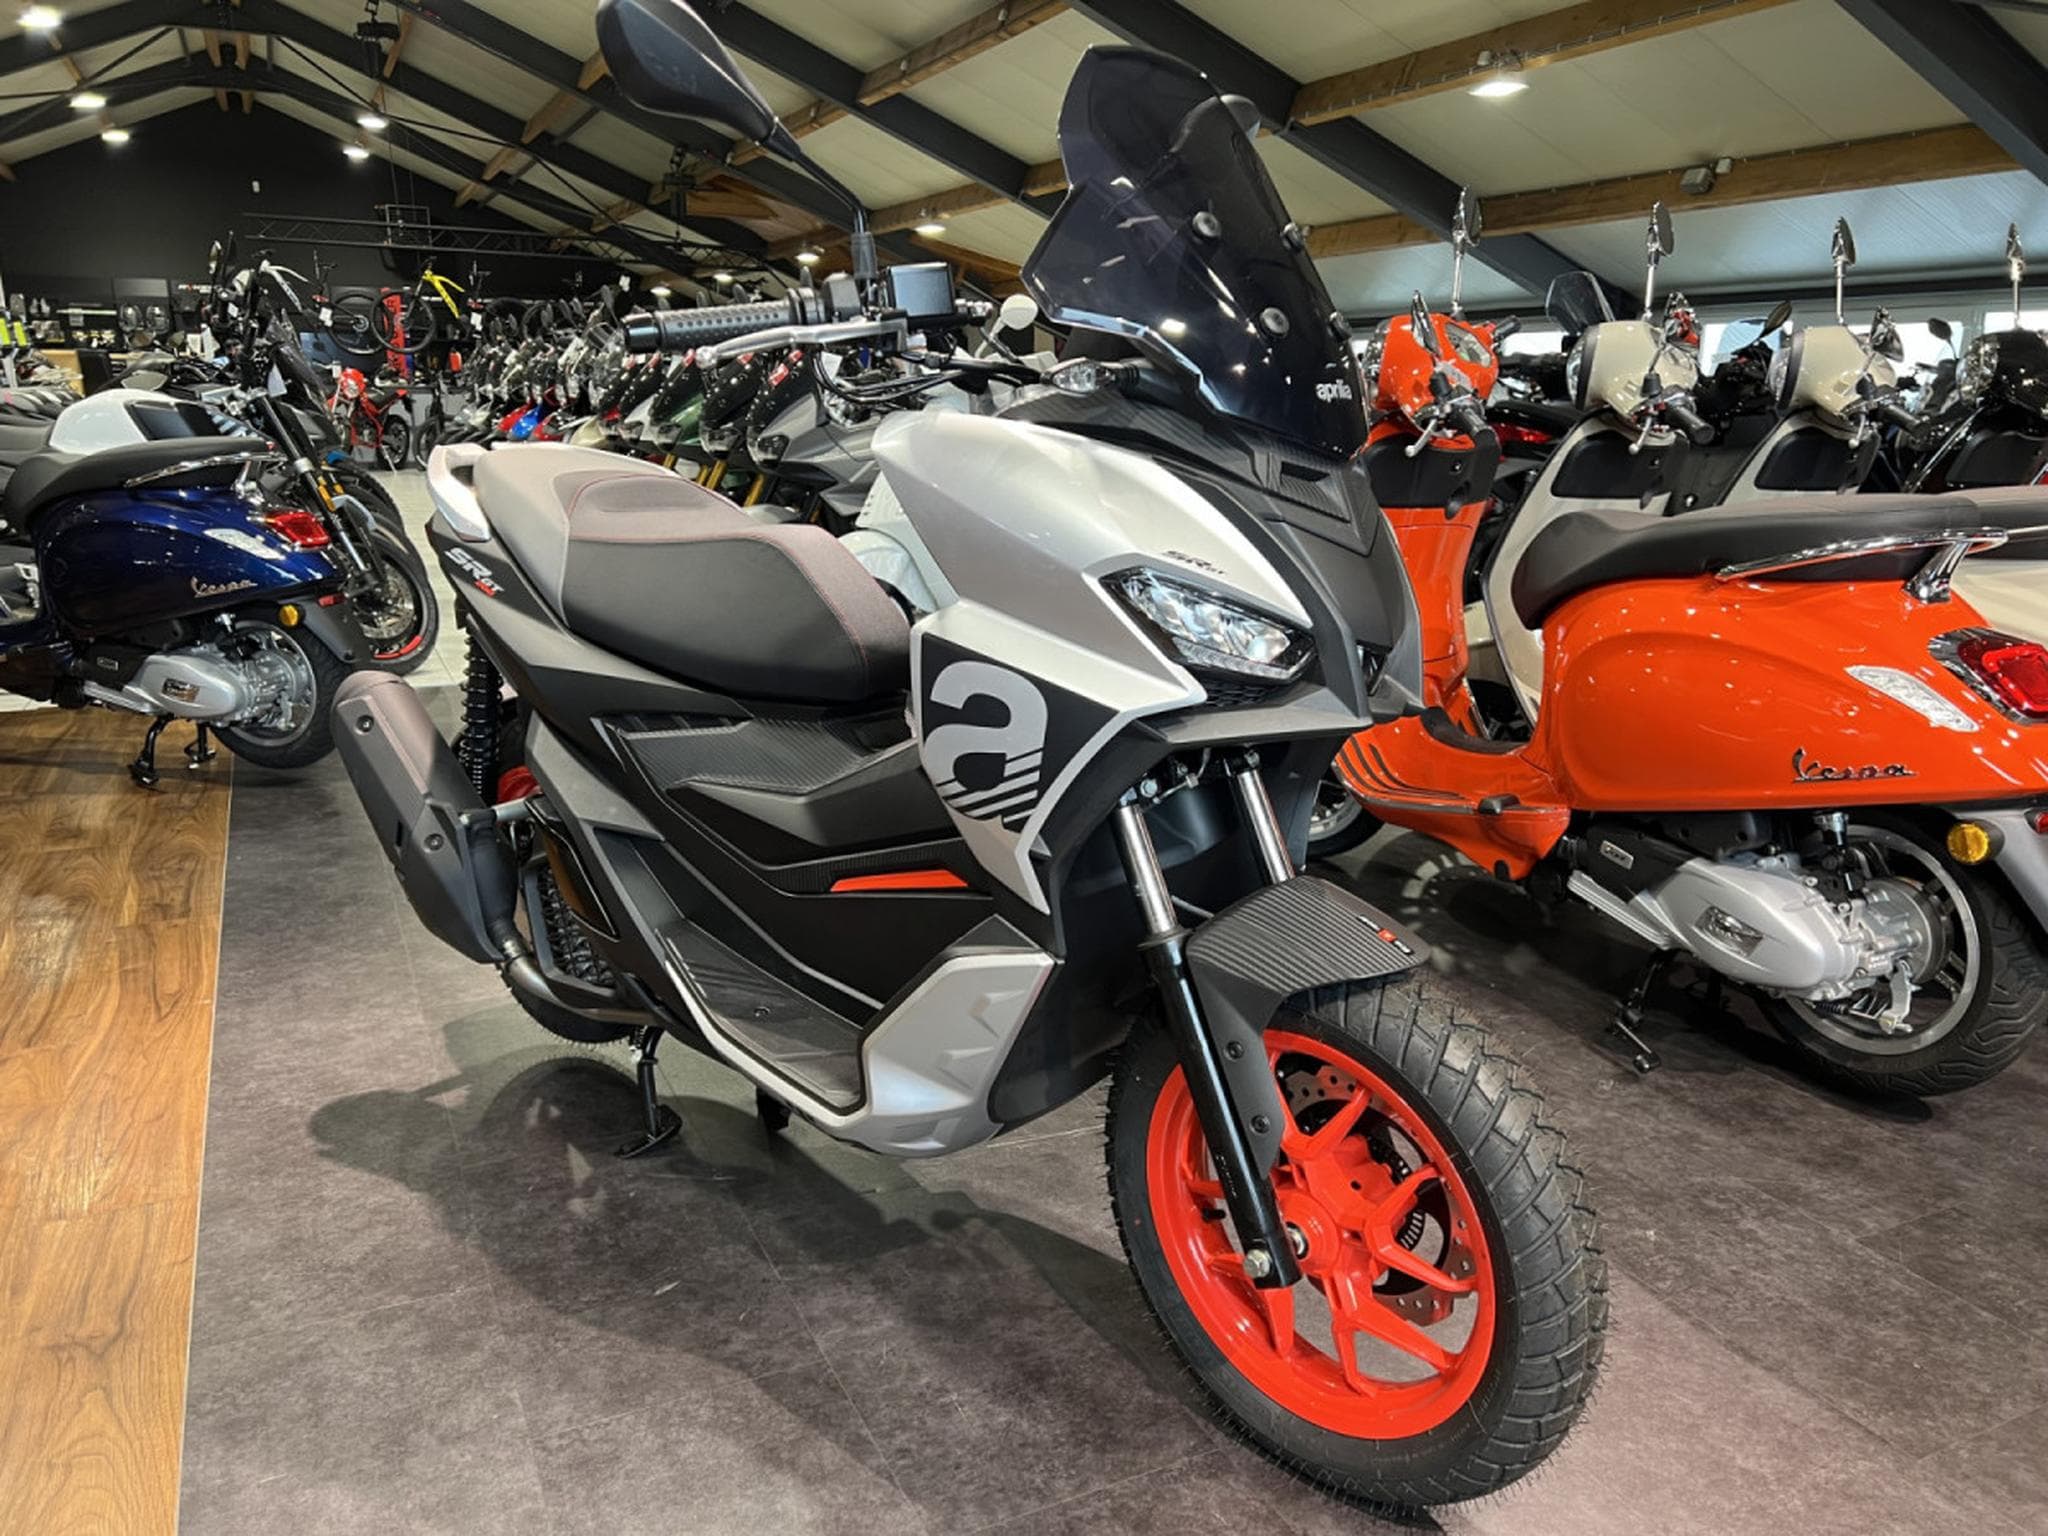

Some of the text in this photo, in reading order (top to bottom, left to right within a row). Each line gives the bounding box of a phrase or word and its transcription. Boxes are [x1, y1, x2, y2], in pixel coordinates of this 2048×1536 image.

[1315, 378, 1353, 403] aprilia
[190, 576, 259, 598] Vespa
[1792, 747, 1917, 783] Vespa
